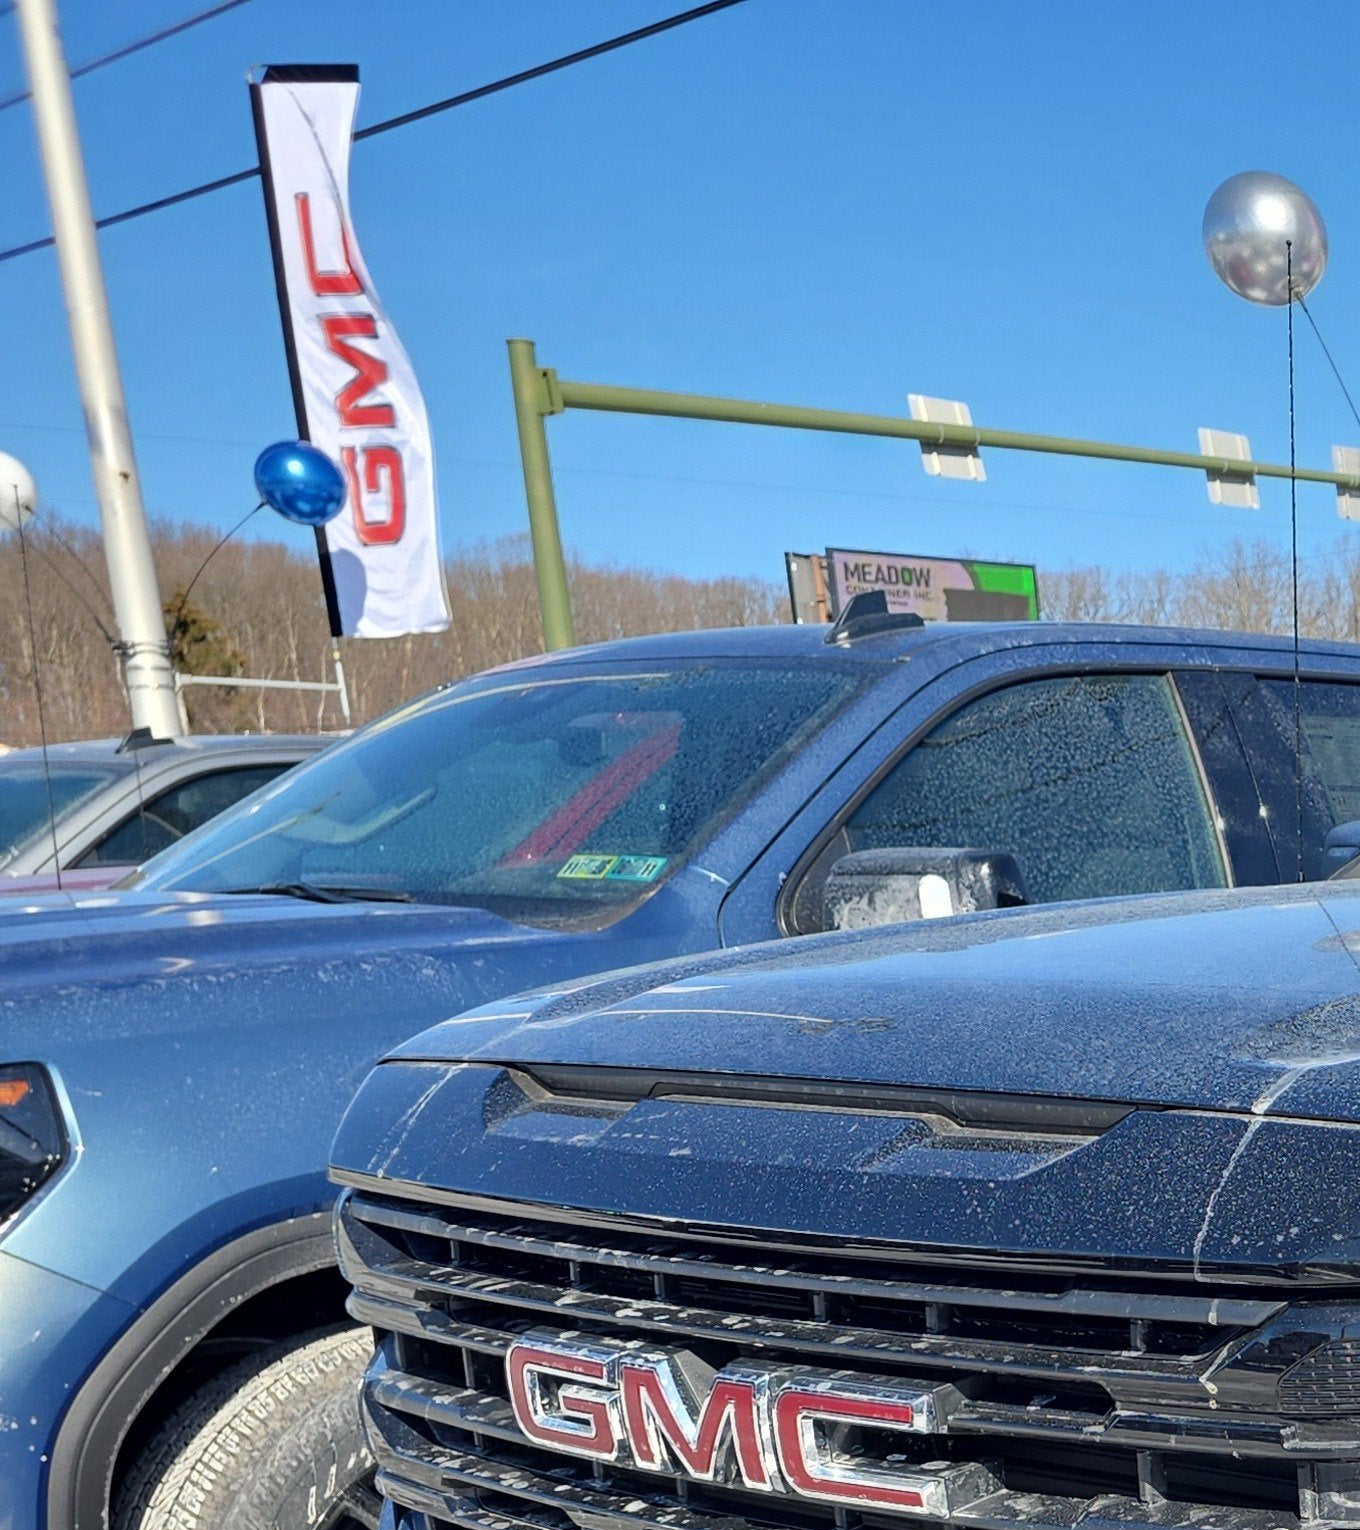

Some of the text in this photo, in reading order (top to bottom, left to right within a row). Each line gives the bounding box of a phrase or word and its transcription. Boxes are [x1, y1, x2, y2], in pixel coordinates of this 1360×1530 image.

[294, 192, 407, 546] GMC
[843, 560, 930, 588] MEADOW
[504, 1341, 949, 1518] GMC
